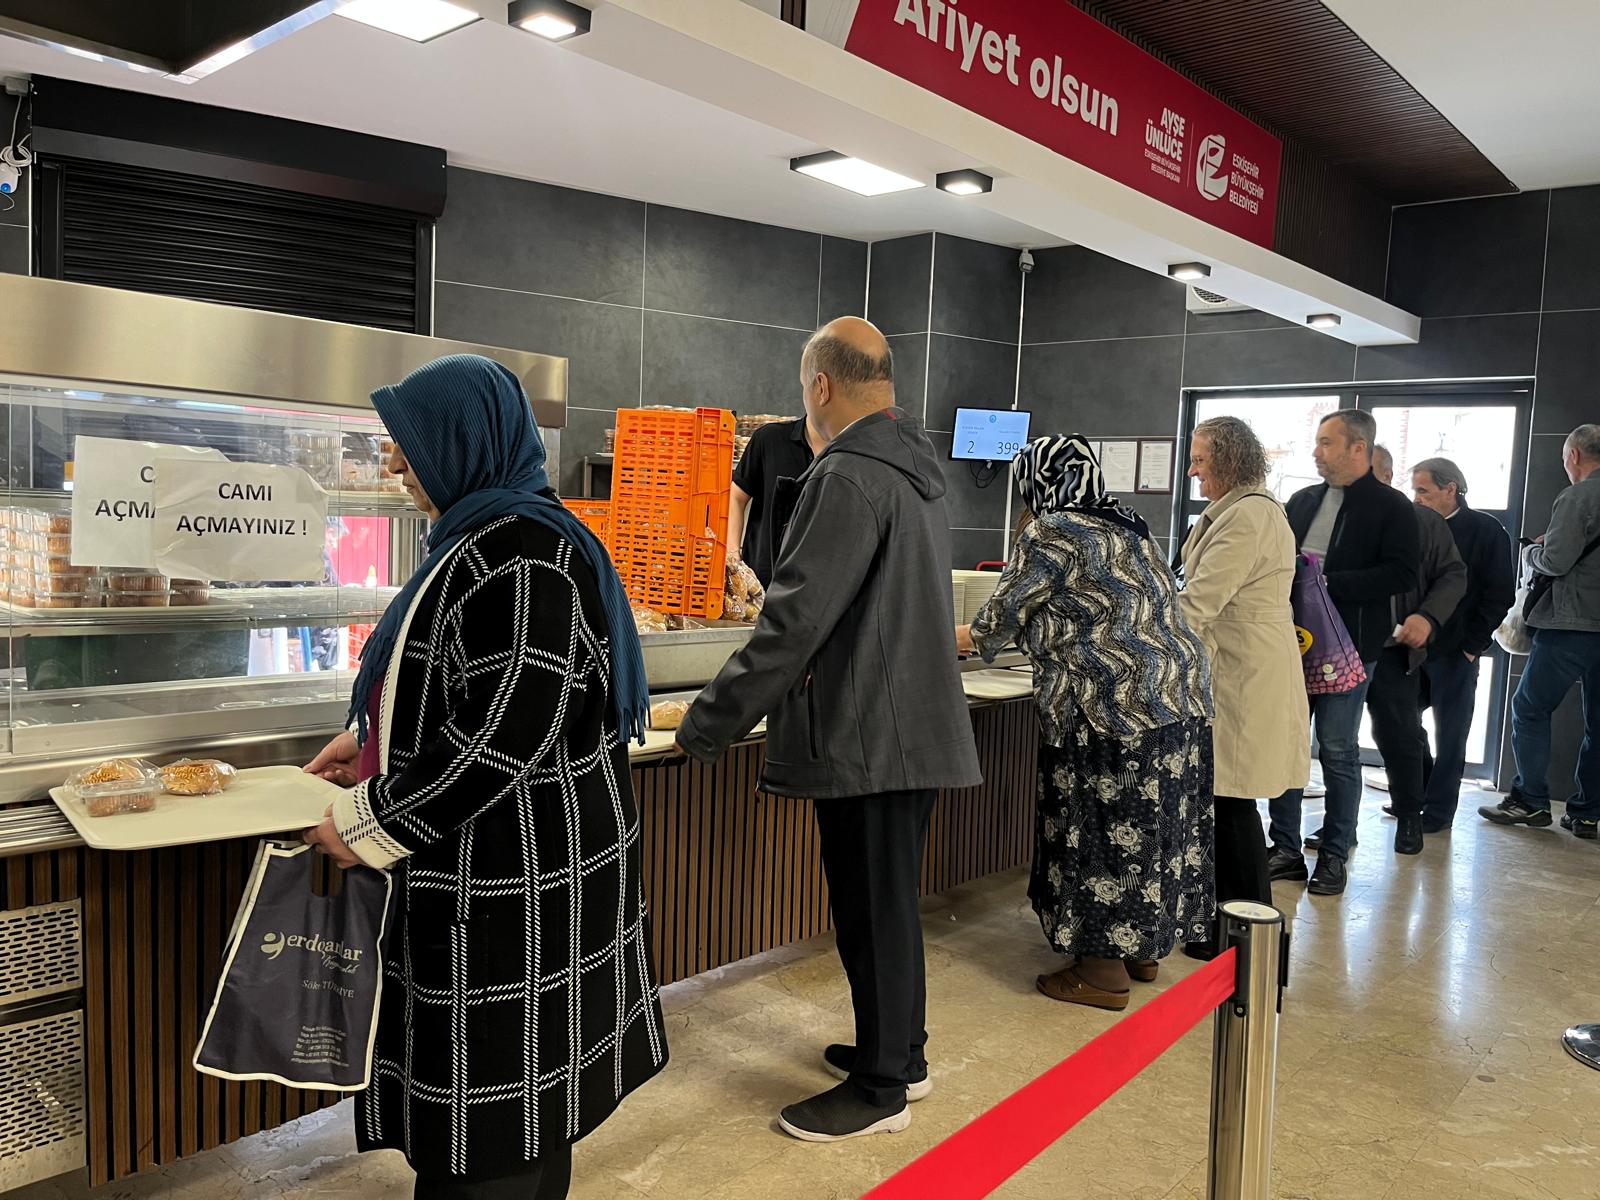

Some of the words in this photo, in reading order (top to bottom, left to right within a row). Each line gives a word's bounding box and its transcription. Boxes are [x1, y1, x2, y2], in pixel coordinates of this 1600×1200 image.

[893, 0, 1021, 86] Afiyet
[1029, 55, 1119, 136] olsun
[1160, 107, 1186, 138] AYŞE
[1232, 153, 1260, 179] ESKİŞEHİR
[967, 440, 975, 454] 2
[996, 441, 1020, 455] 399
[140, 465, 156, 483] C
[218, 482, 272, 501] CAMI
[176, 515, 296, 536] AÇMAYINIZ
